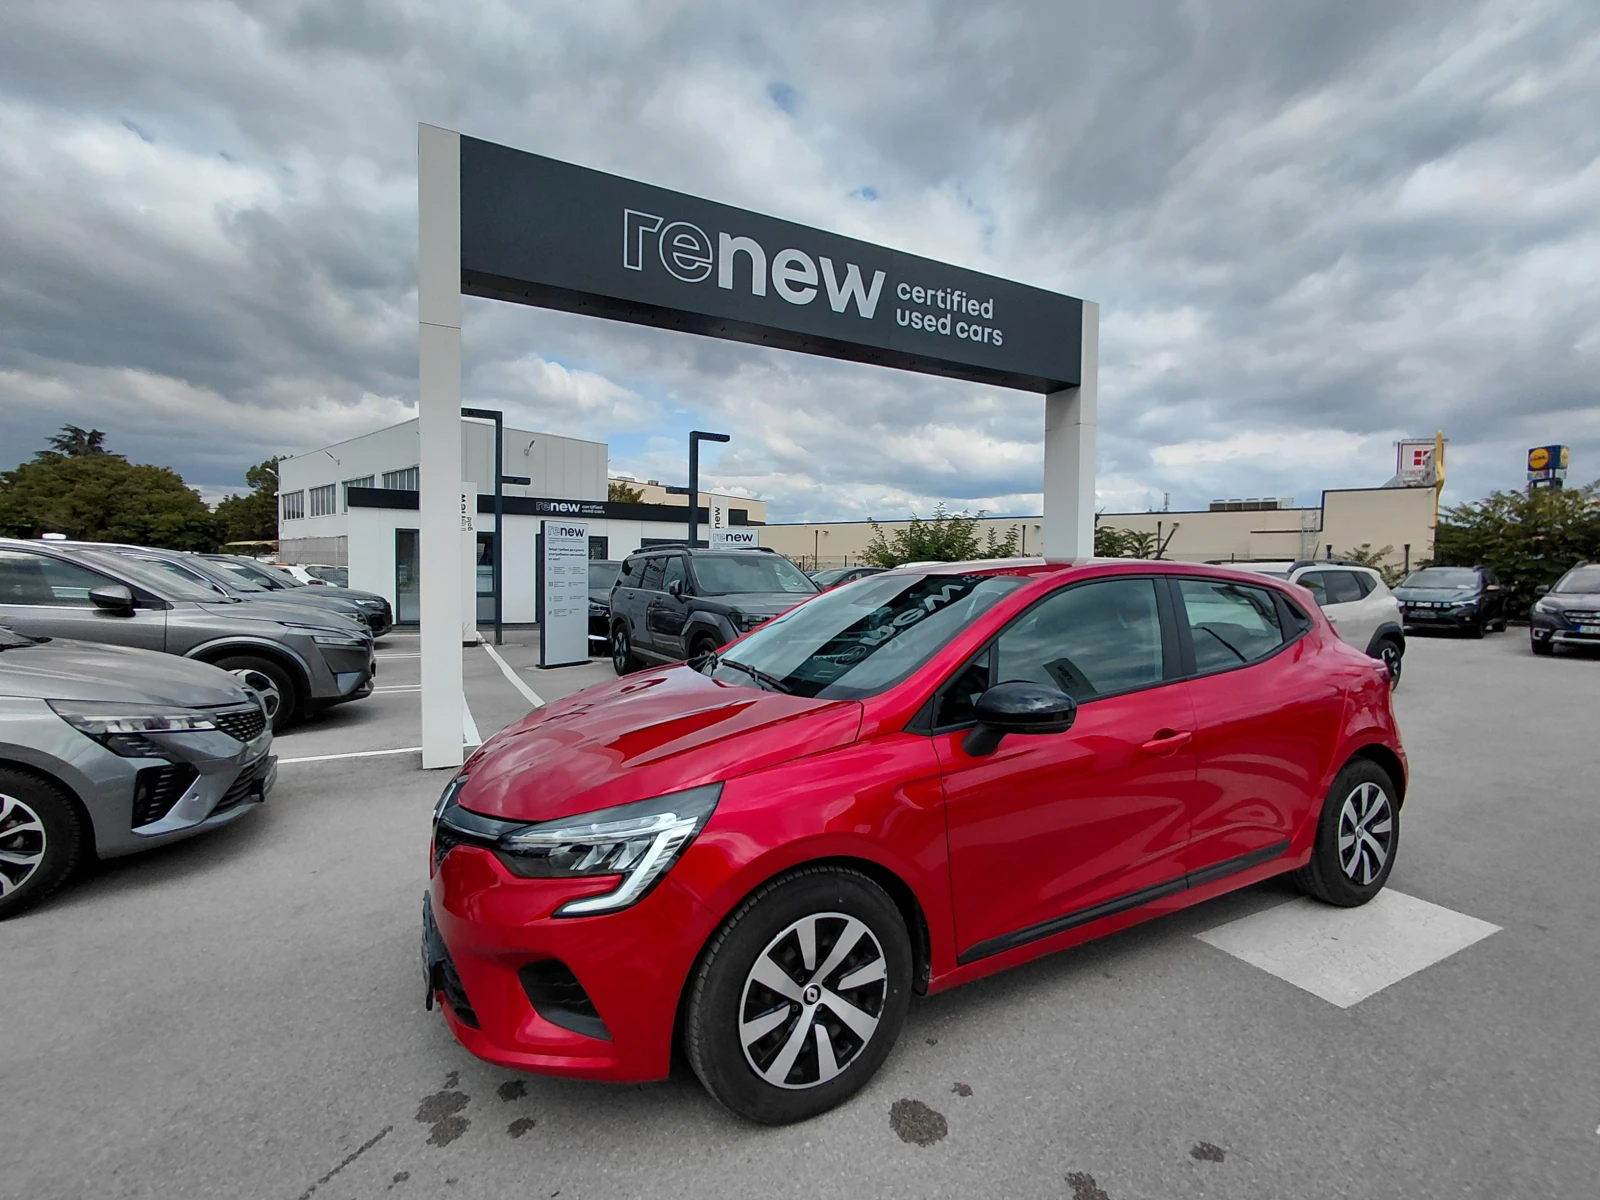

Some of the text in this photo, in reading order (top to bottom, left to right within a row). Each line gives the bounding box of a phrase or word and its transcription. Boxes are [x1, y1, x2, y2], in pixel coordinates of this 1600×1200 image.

[623, 208, 886, 319] renew
[896, 282, 994, 320] certified
[896, 308, 1003, 346] used cars
[536, 501, 580, 513] renew
[548, 526, 585, 538] renew
[713, 533, 753, 542] renew
